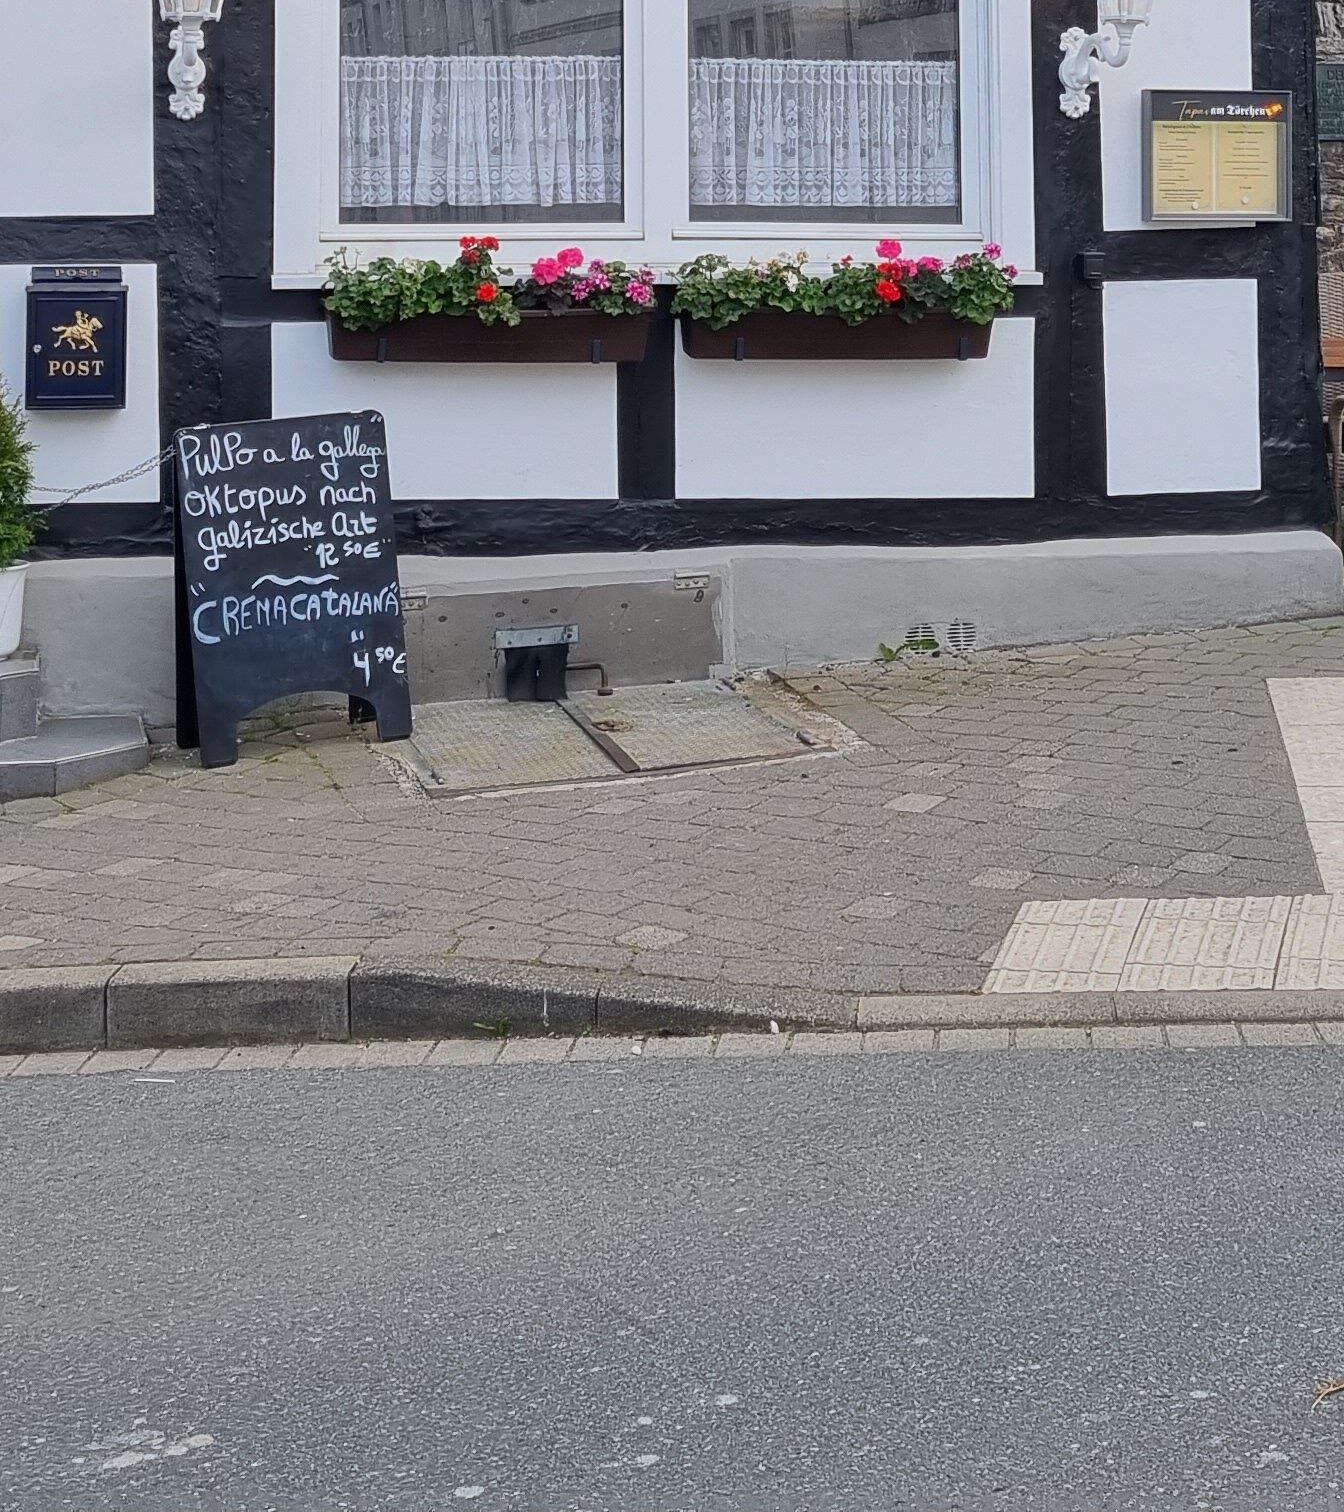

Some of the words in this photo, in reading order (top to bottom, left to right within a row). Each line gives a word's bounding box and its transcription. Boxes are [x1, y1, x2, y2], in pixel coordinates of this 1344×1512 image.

[1172, 100, 1209, 121] Tapas
[1210, 107, 1225, 116] am
[55, 268, 100, 277] POST
[48, 360, 104, 377] POST
[262, 449, 285, 464] a
[291, 432, 315, 462] la
[319, 480, 377, 507] nach
